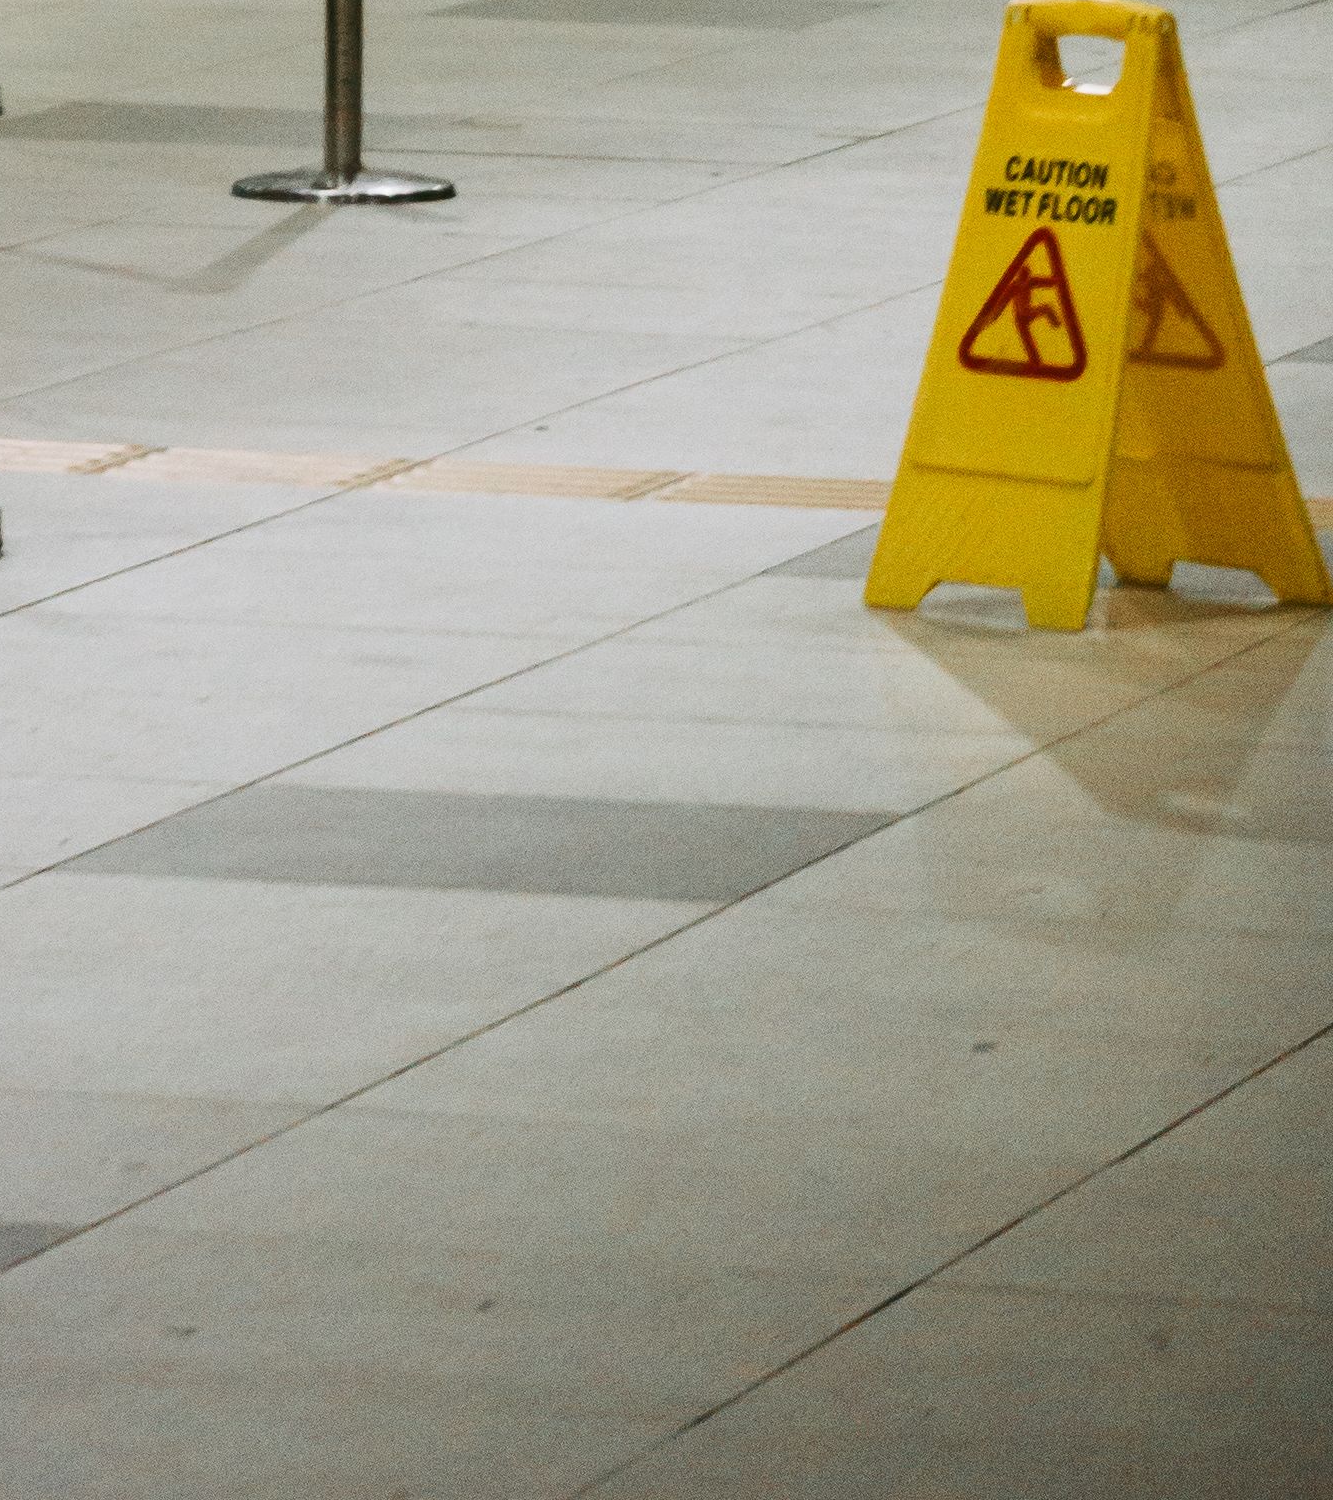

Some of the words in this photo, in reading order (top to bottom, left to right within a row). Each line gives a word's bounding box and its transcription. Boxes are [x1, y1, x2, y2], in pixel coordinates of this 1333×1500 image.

[1004, 155, 1109, 191] CAUTION
[985, 187, 1035, 217] WET
[1036, 192, 1118, 226] FLOOR
